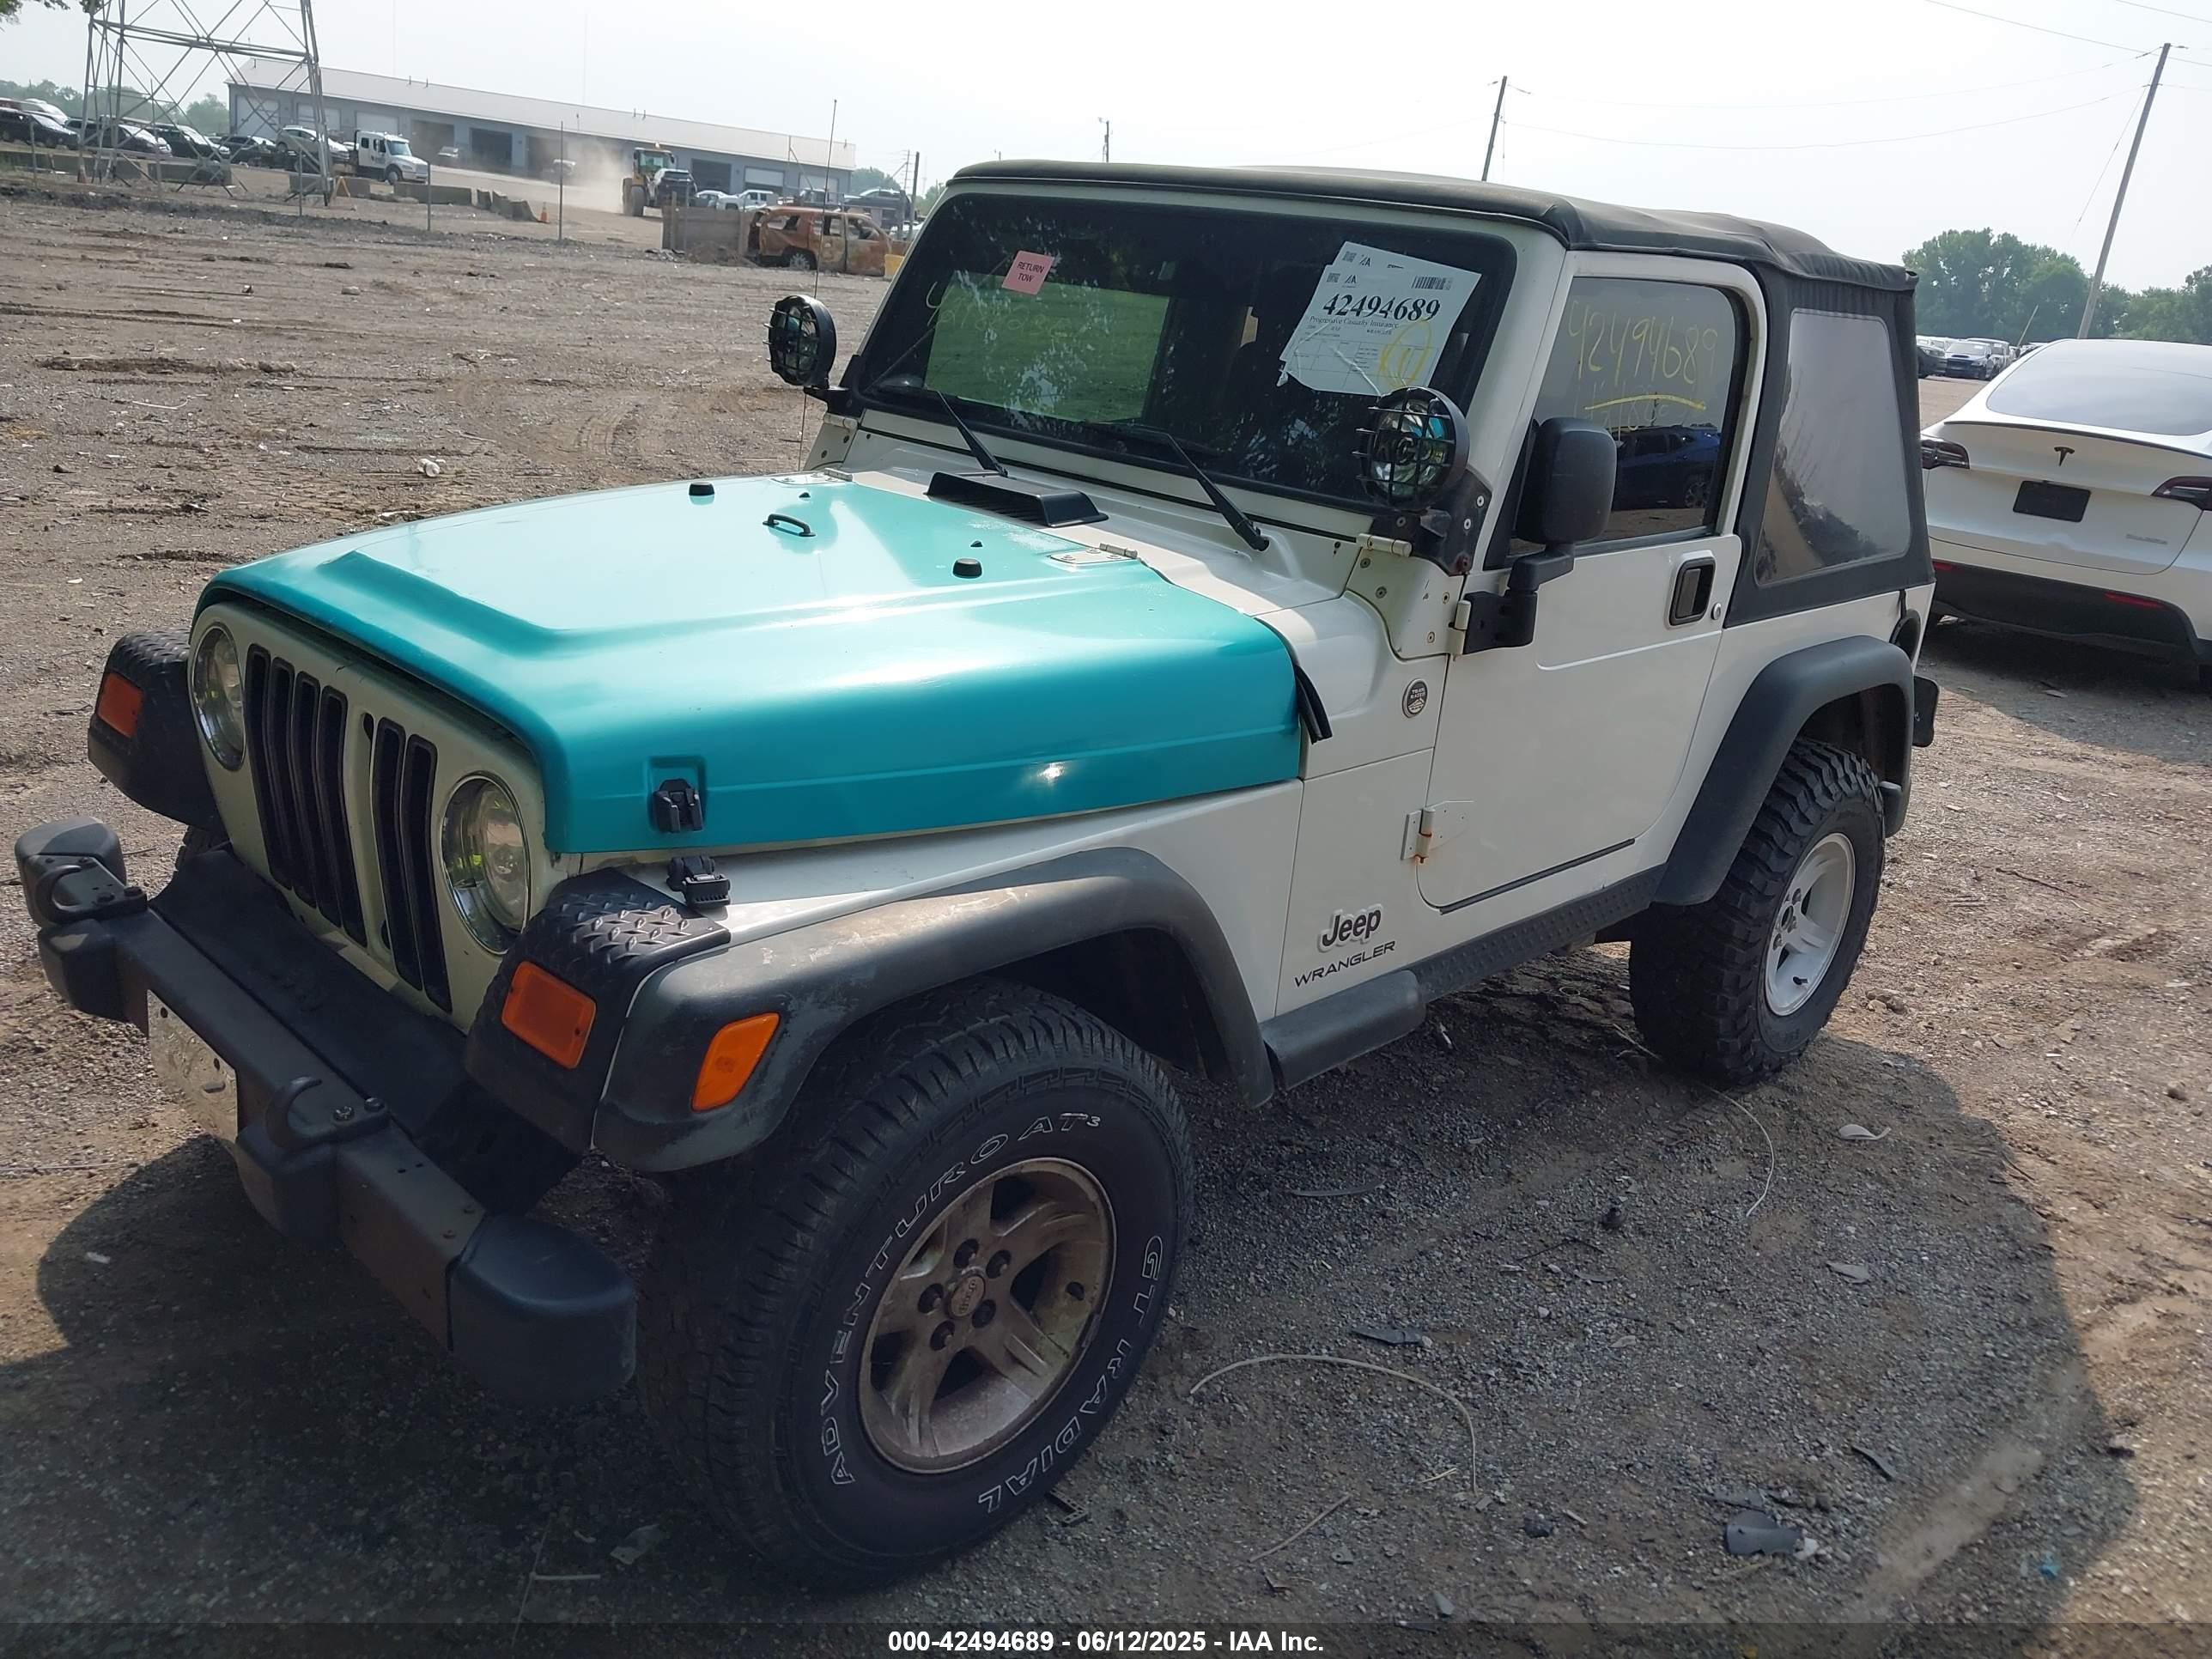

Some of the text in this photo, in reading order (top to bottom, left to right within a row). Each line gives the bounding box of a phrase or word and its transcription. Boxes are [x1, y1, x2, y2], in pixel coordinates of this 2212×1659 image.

[1017, 261, 1045, 273] RETURN
[1018, 272, 1034, 283] TOW
[1322, 293, 1441, 322] 42494689
[1321, 908, 1382, 948] Jeep
[1294, 940, 1396, 988] WRANGLER
[820, 1133, 1009, 1486] ADVENTURO
[977, 1235, 1164, 1514] GT RADIAL
